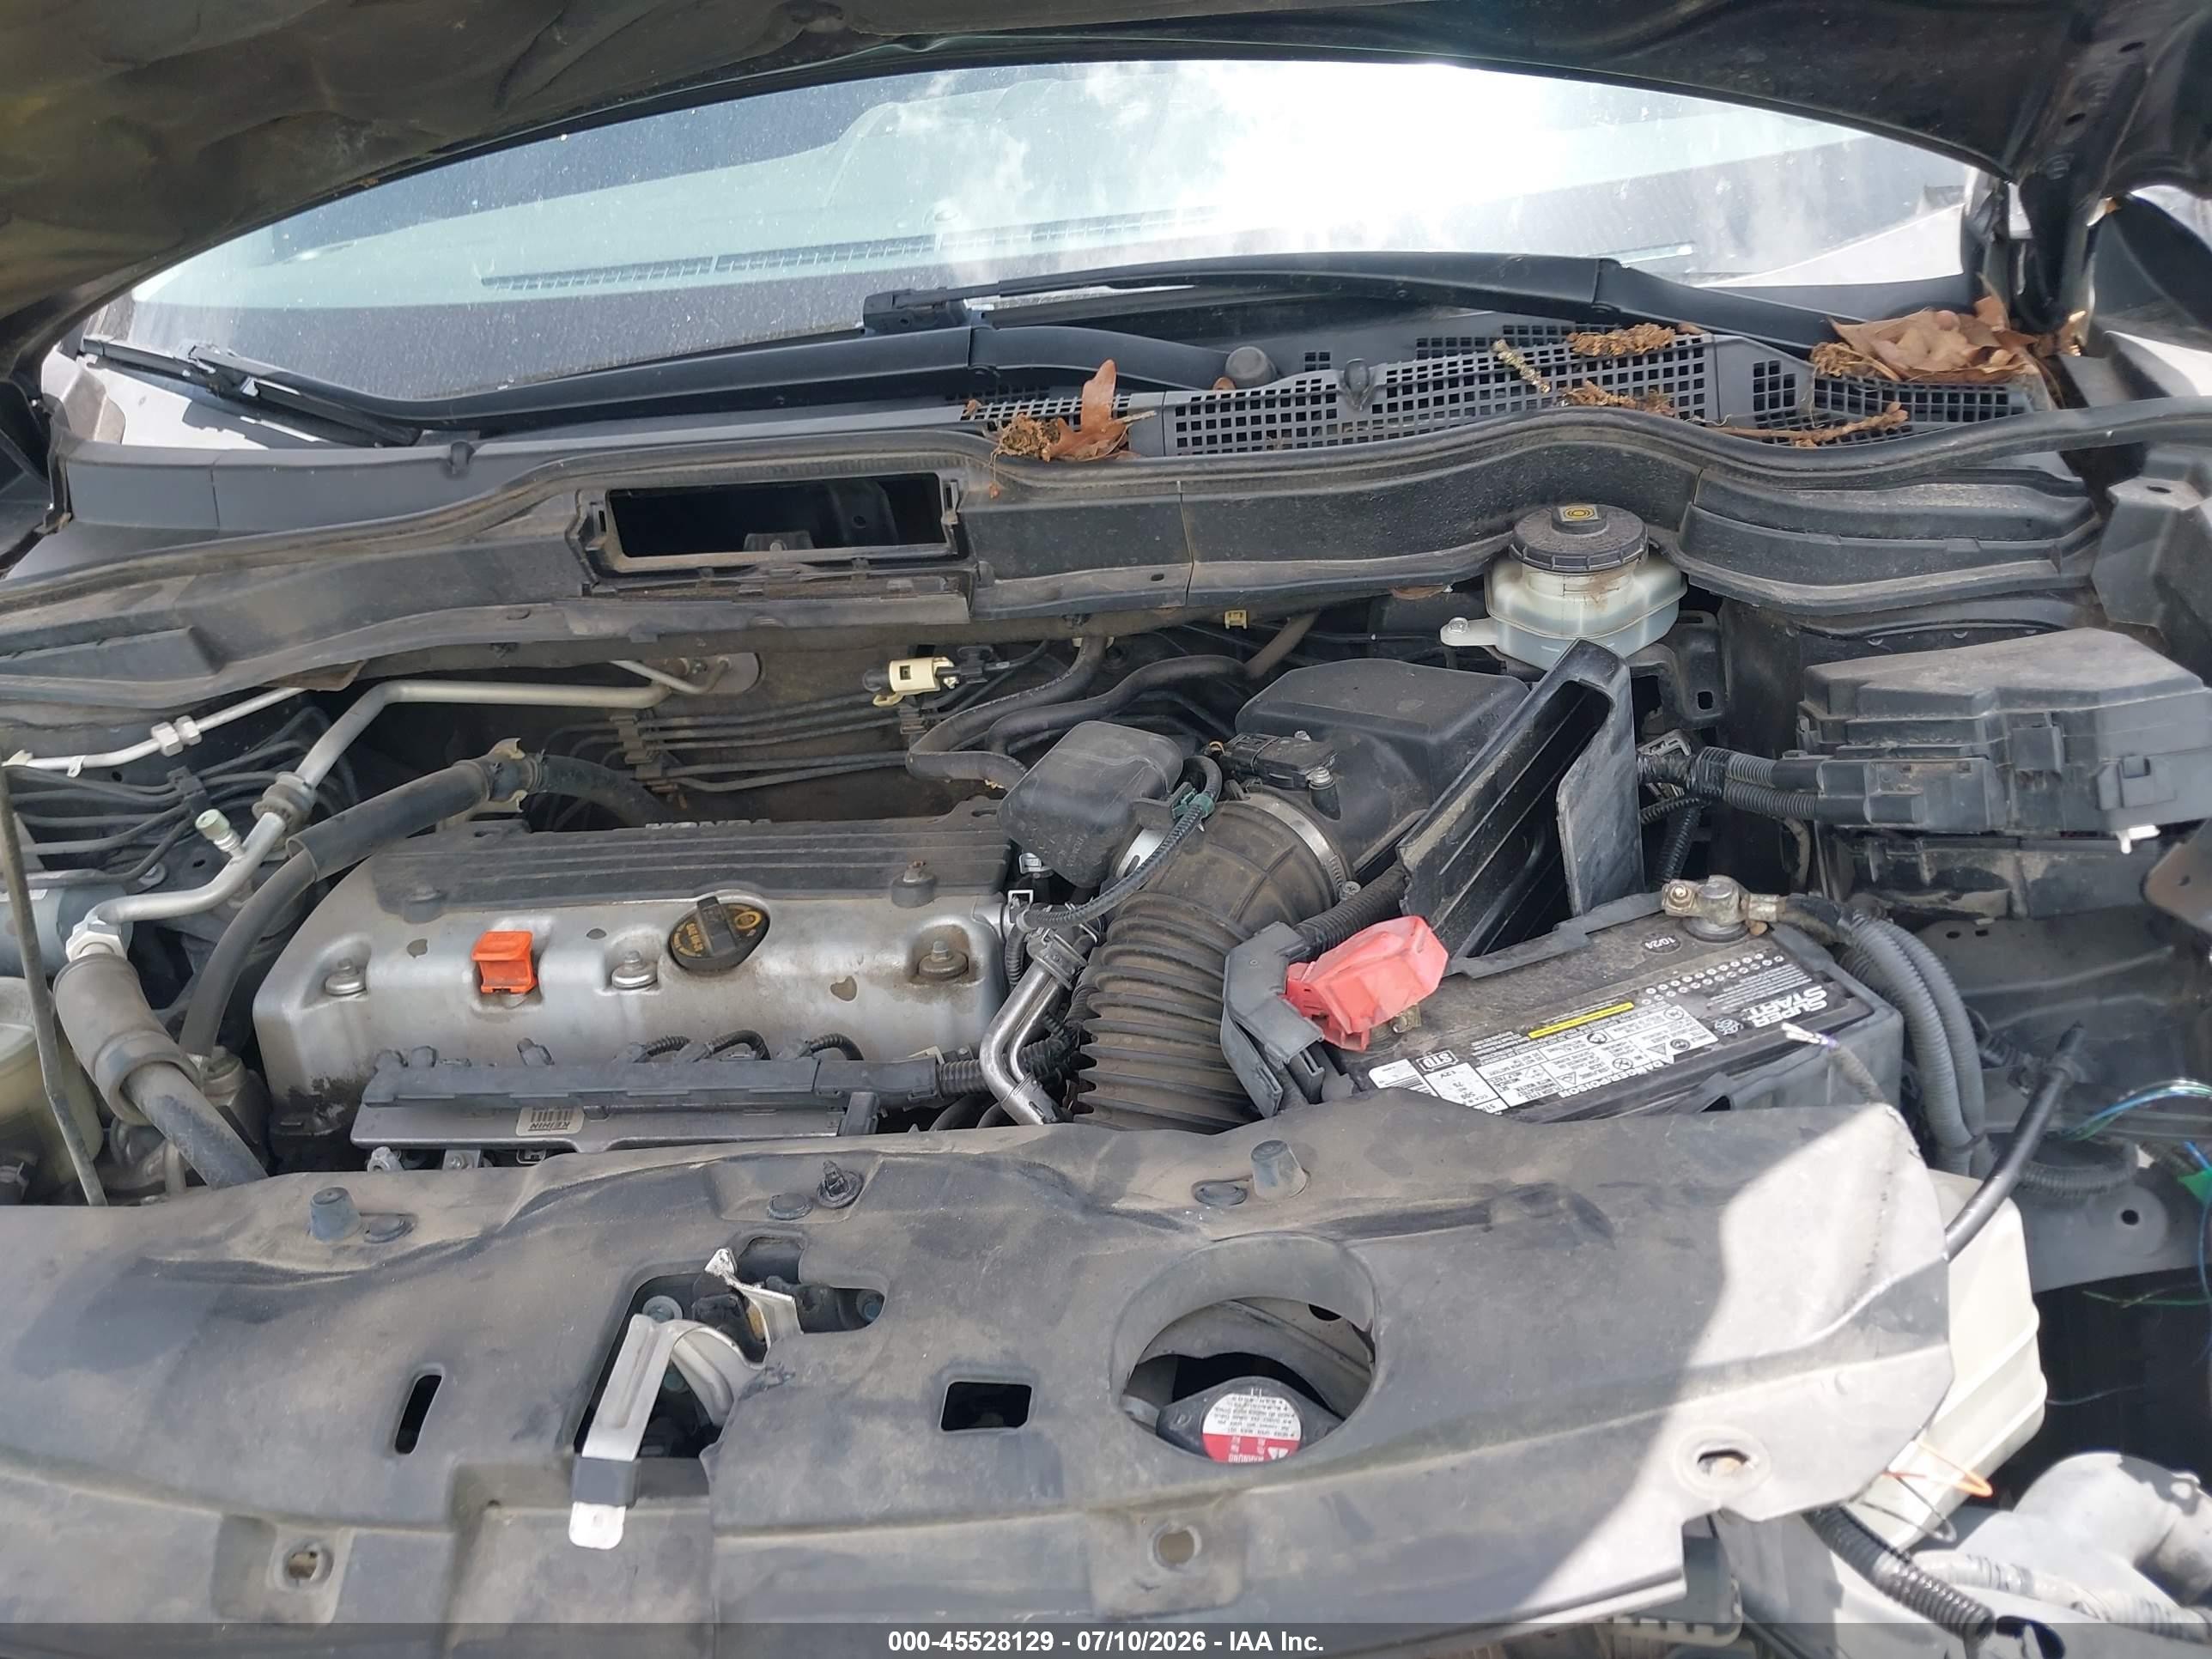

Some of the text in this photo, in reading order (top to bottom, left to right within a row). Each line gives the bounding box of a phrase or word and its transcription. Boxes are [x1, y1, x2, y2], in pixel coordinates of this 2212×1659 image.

[1742, 985, 1828, 1021] START
[1752, 998, 1828, 1029] SUPER
[1423, 1052, 1454, 1069] STD
